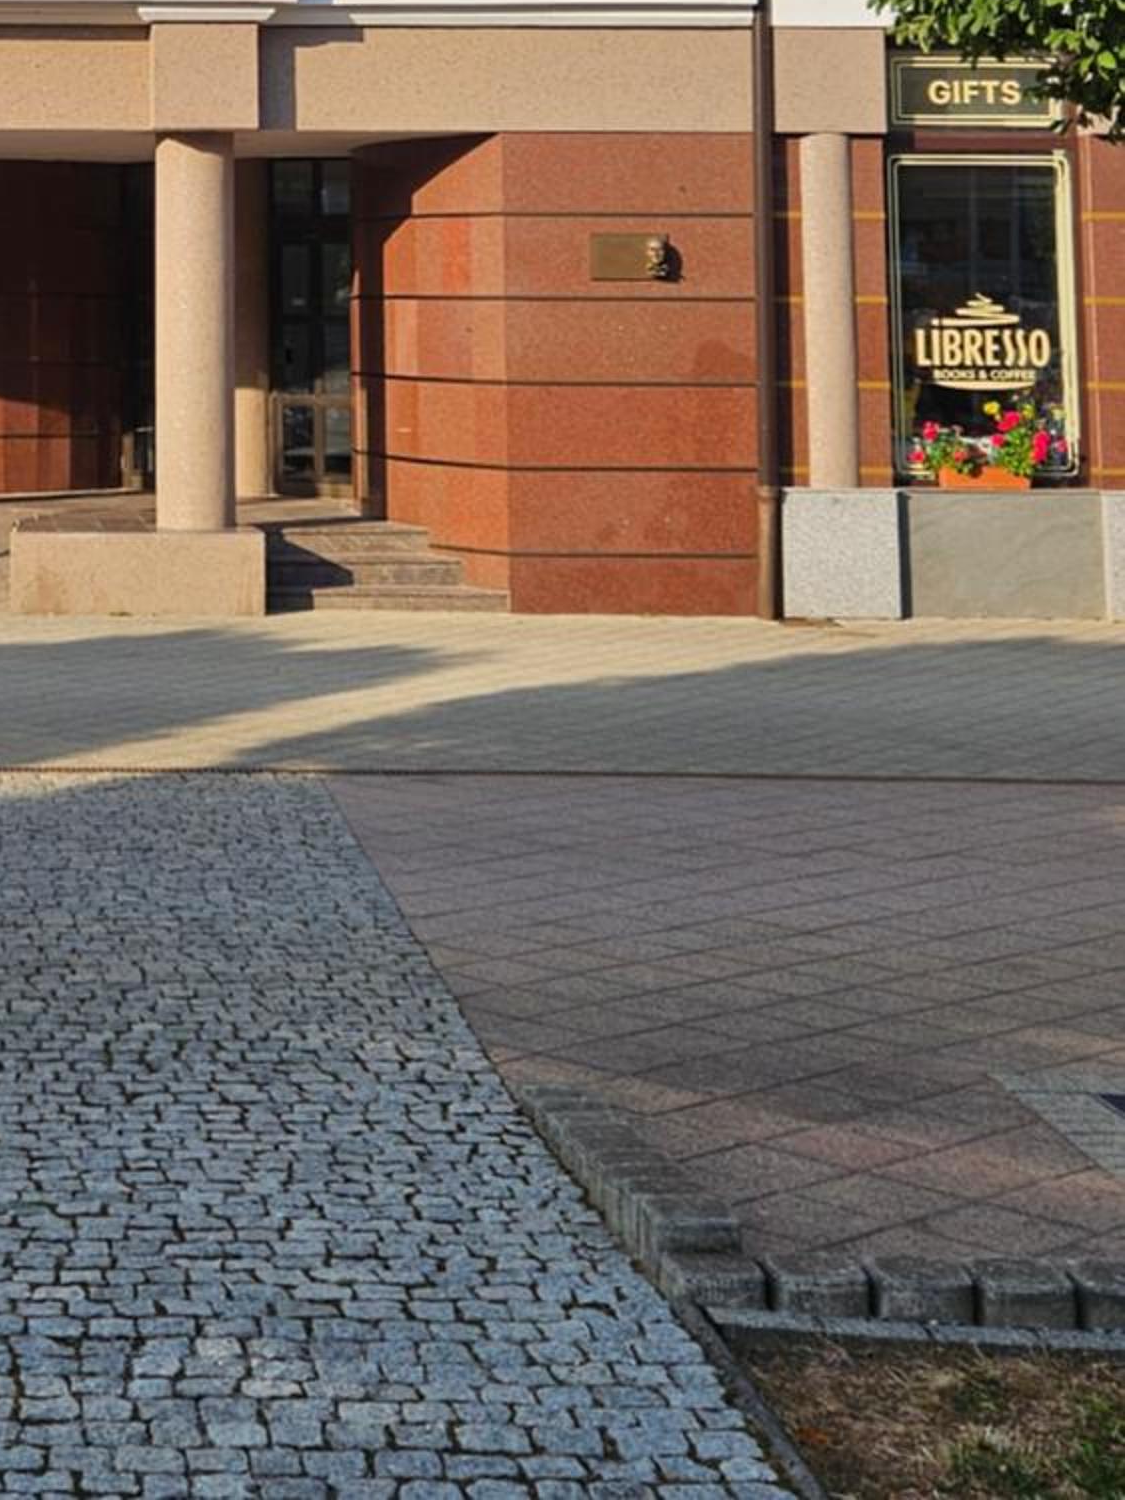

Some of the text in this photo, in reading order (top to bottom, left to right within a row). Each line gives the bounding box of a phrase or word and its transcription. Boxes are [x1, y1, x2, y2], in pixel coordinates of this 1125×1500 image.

[928, 79, 1022, 105] GIFTS
[915, 328, 1052, 367] LIBRESSO
[933, 369, 1036, 381] BOOKS & COFFEE
